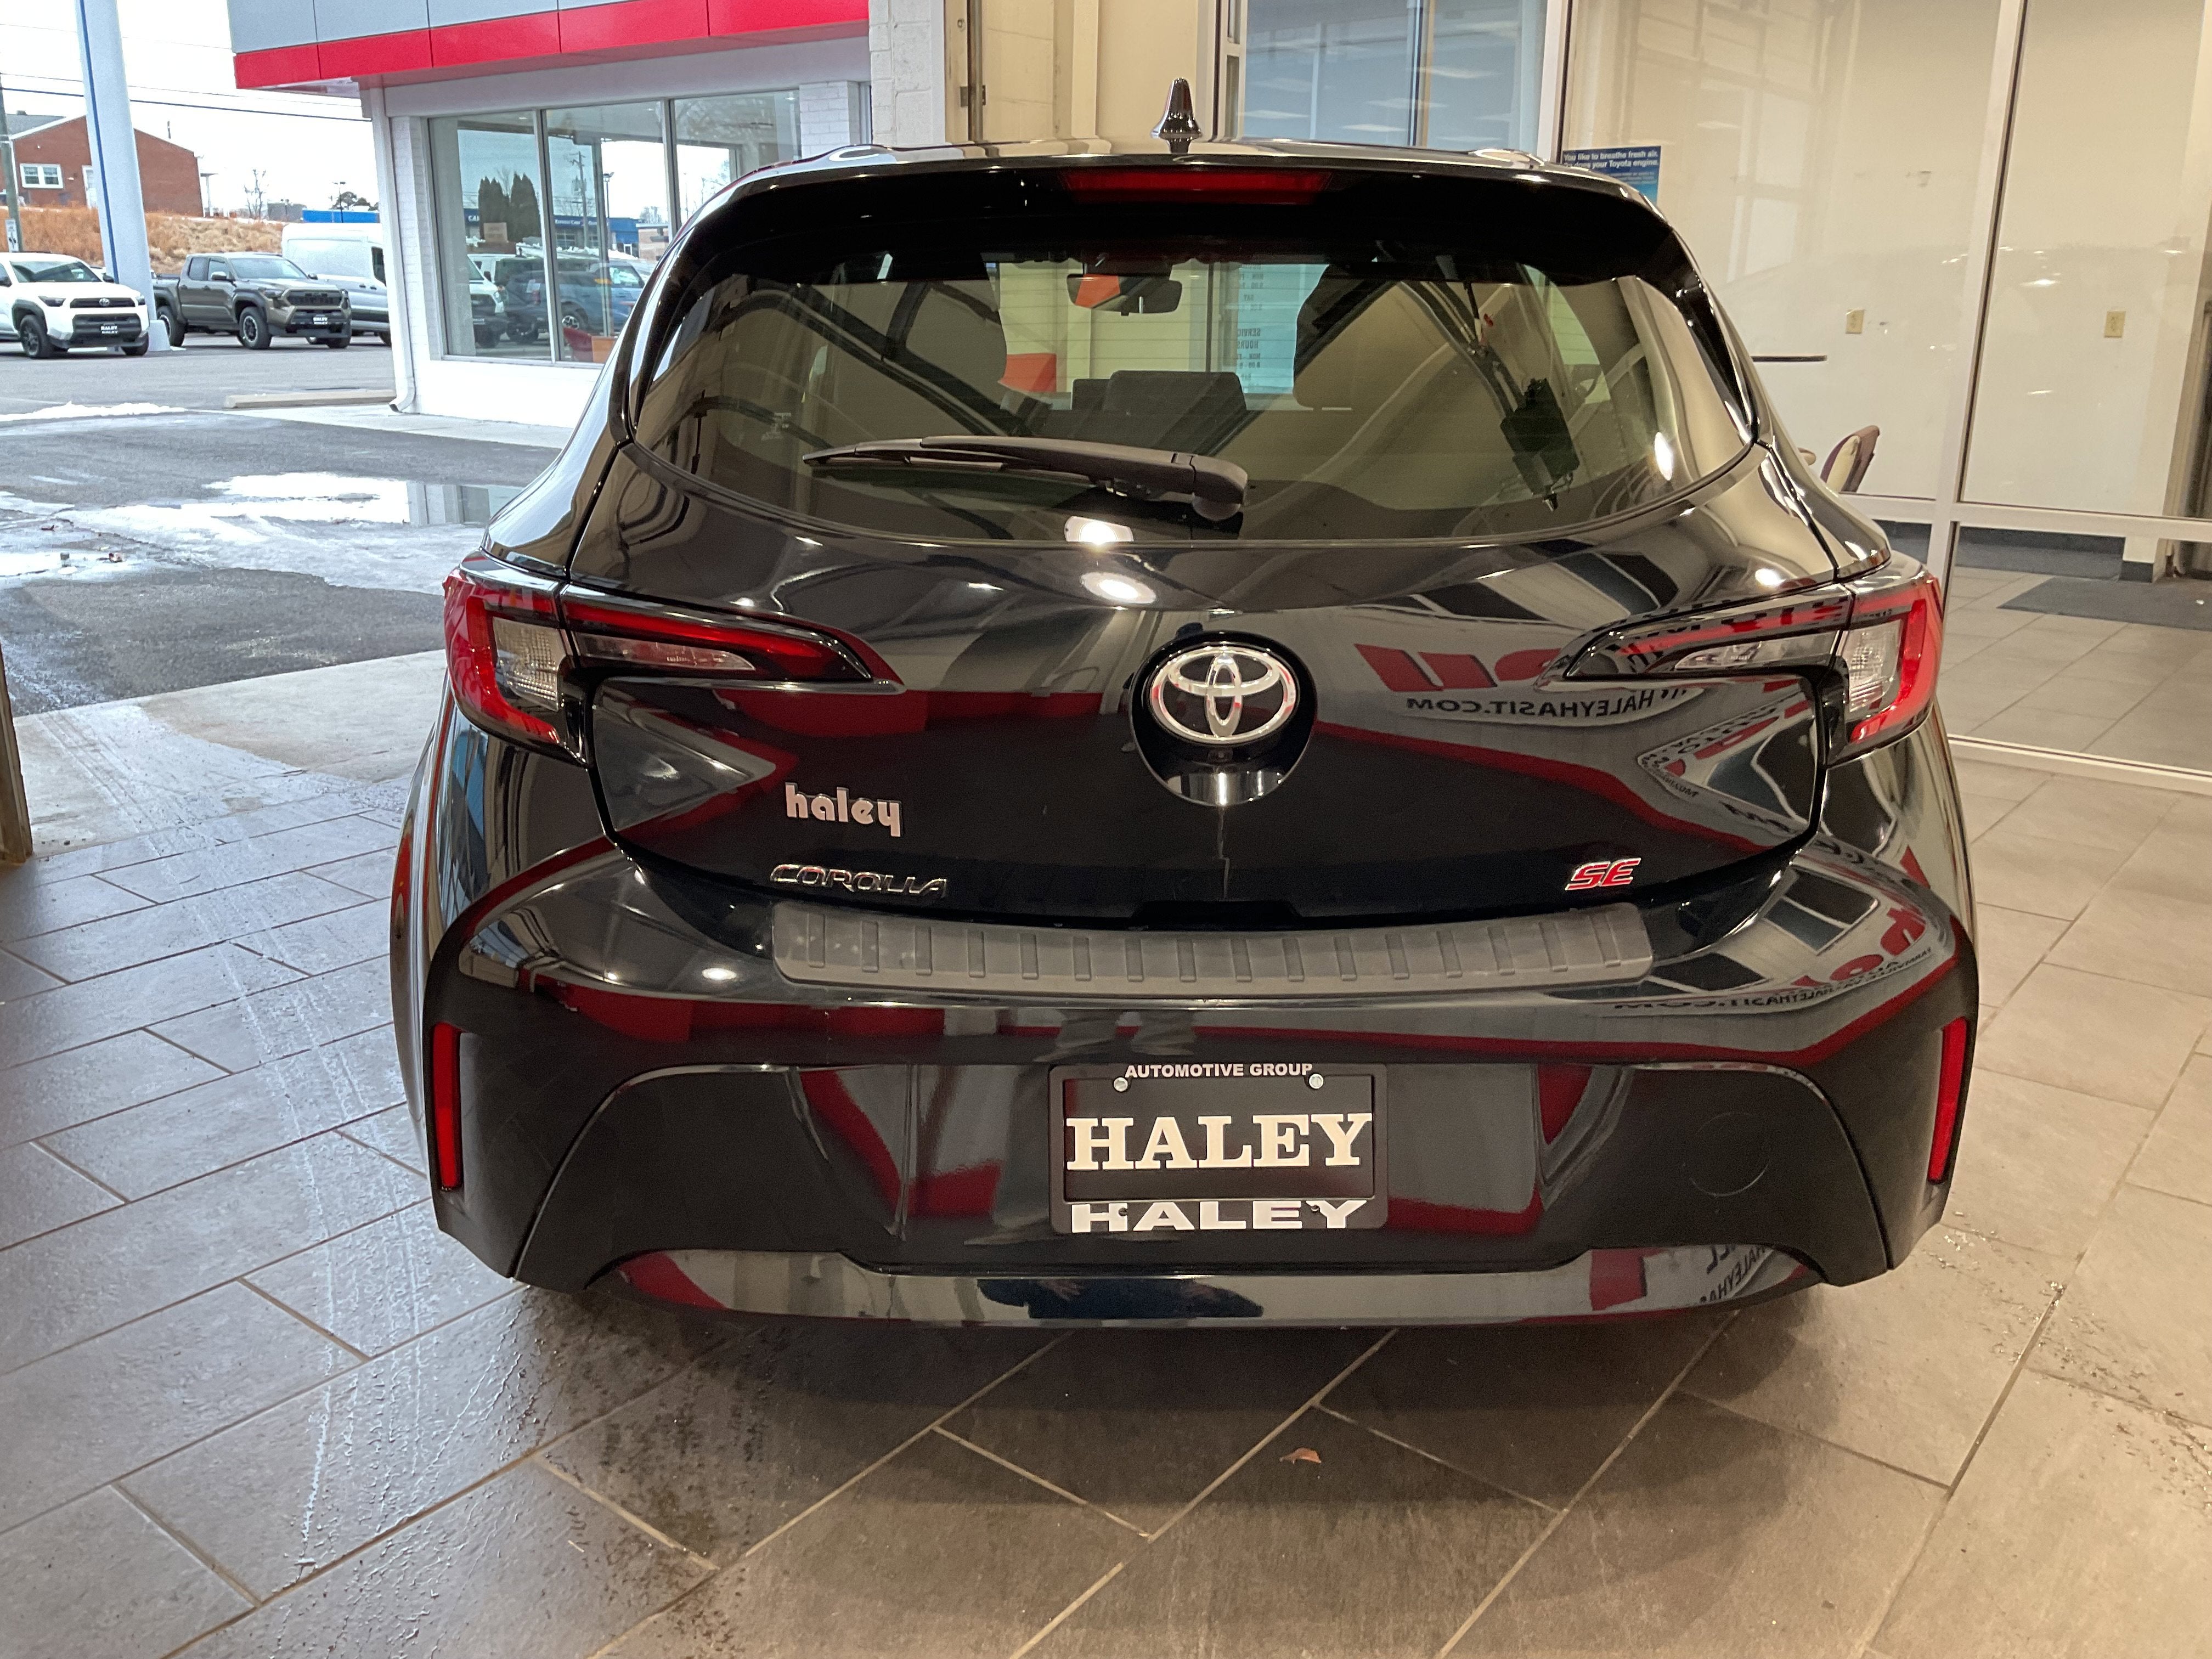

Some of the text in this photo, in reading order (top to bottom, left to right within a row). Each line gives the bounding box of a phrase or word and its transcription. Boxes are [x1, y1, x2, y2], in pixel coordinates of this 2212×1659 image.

[1592, 161, 1607, 170] your
[1609, 160, 1632, 168] Toyota
[1633, 159, 1658, 167] engine.
[1600, 151, 1627, 160] breathe
[785, 782, 902, 837] haley
[770, 864, 947, 898] COROLLA
[1565, 857, 1641, 891] SE
[1125, 1062, 1313, 1079] AUTOMOTIVE GROUP
[1066, 1112, 1372, 1170] HALEY
[1071, 1200, 1367, 1233] HALEY
